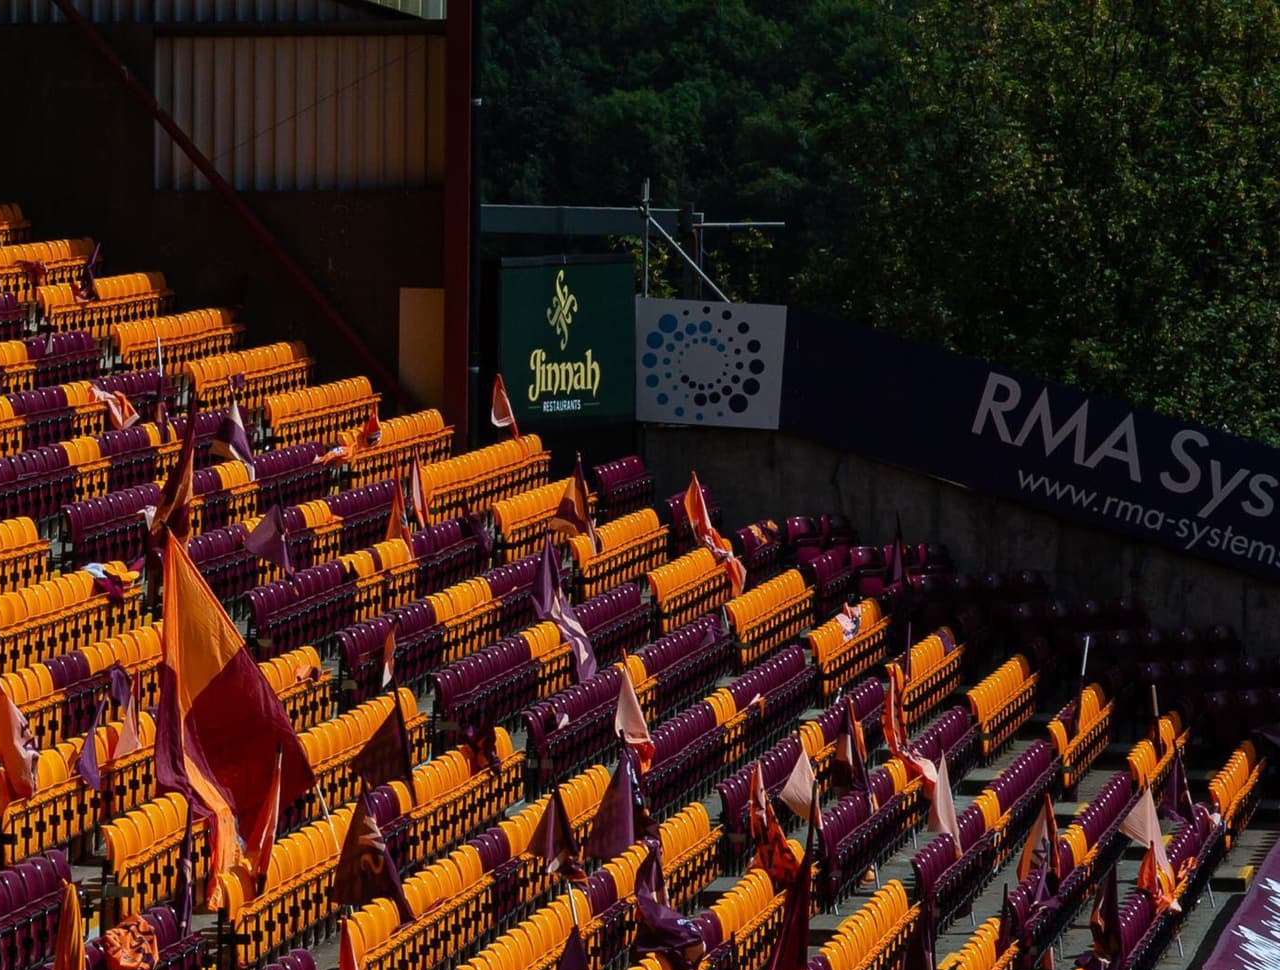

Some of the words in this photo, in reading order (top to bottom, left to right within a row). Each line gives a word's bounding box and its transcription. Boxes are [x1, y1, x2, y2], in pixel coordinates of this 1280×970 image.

[528, 348, 600, 402] Jinnah
[543, 400, 581, 412] RESTAURANTS
[971, 371, 1142, 483] RMA
[1160, 429, 1280, 518] Sys
